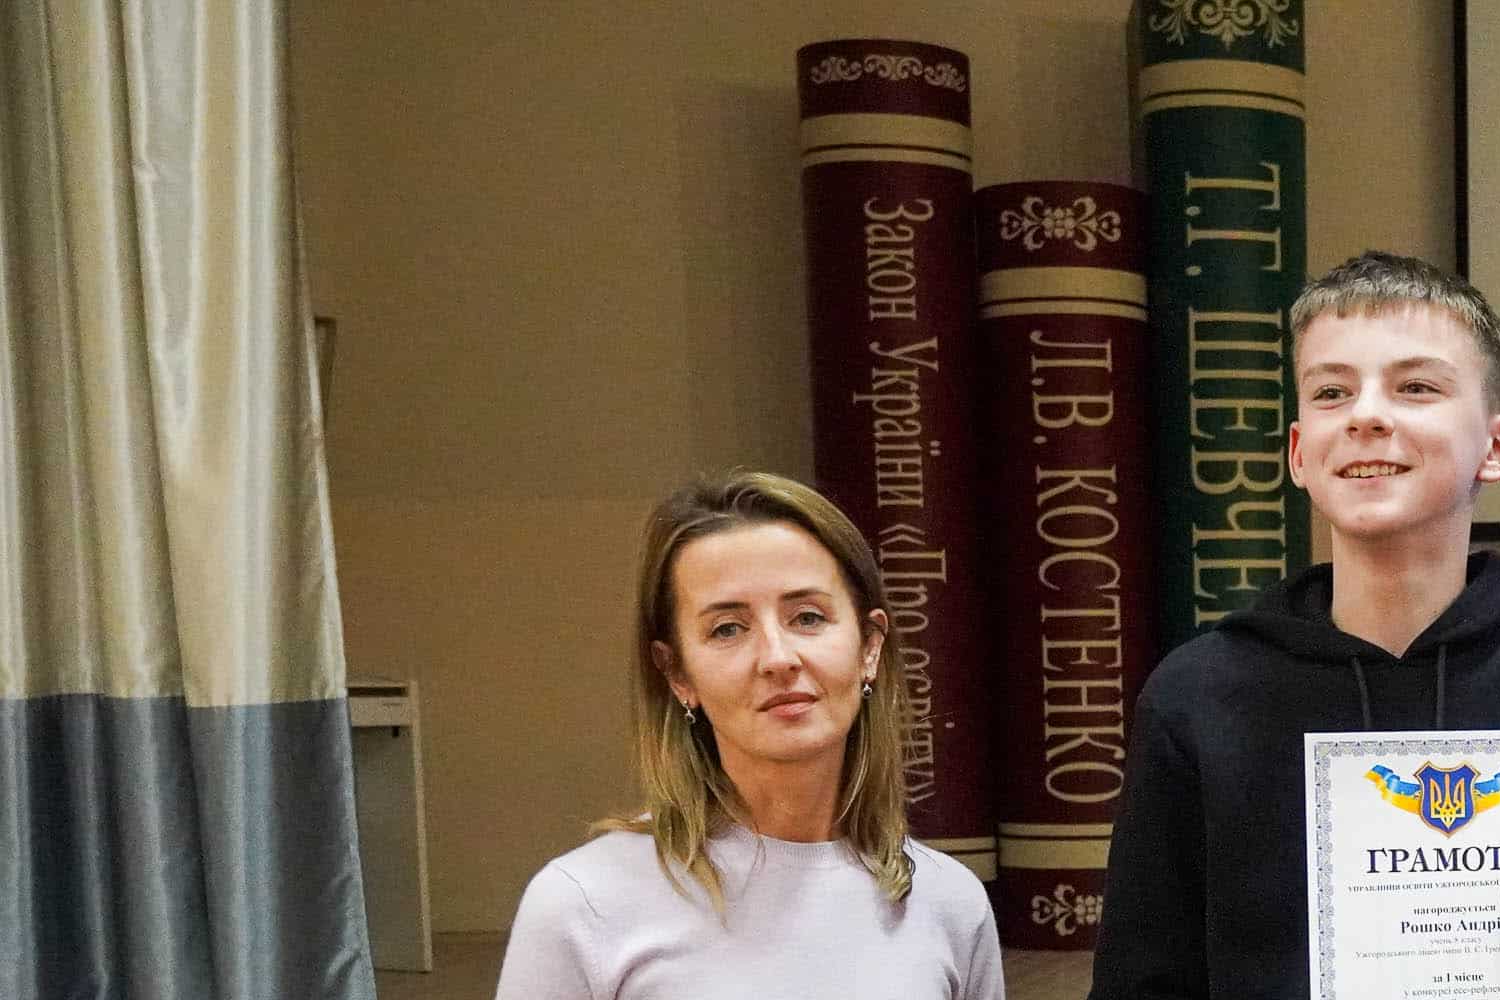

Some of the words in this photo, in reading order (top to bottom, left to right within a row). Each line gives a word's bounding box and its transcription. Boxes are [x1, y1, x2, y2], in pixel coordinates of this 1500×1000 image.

[864, 197, 935, 322] Закон
[853, 337, 941, 507] України
[1030, 330, 1115, 446] Л.В.
[1187, 308, 1288, 628] ШЕВЧЕ
[1036, 465, 1126, 804] КОСТЕНКО
[1401, 920, 1452, 934] Рошко
